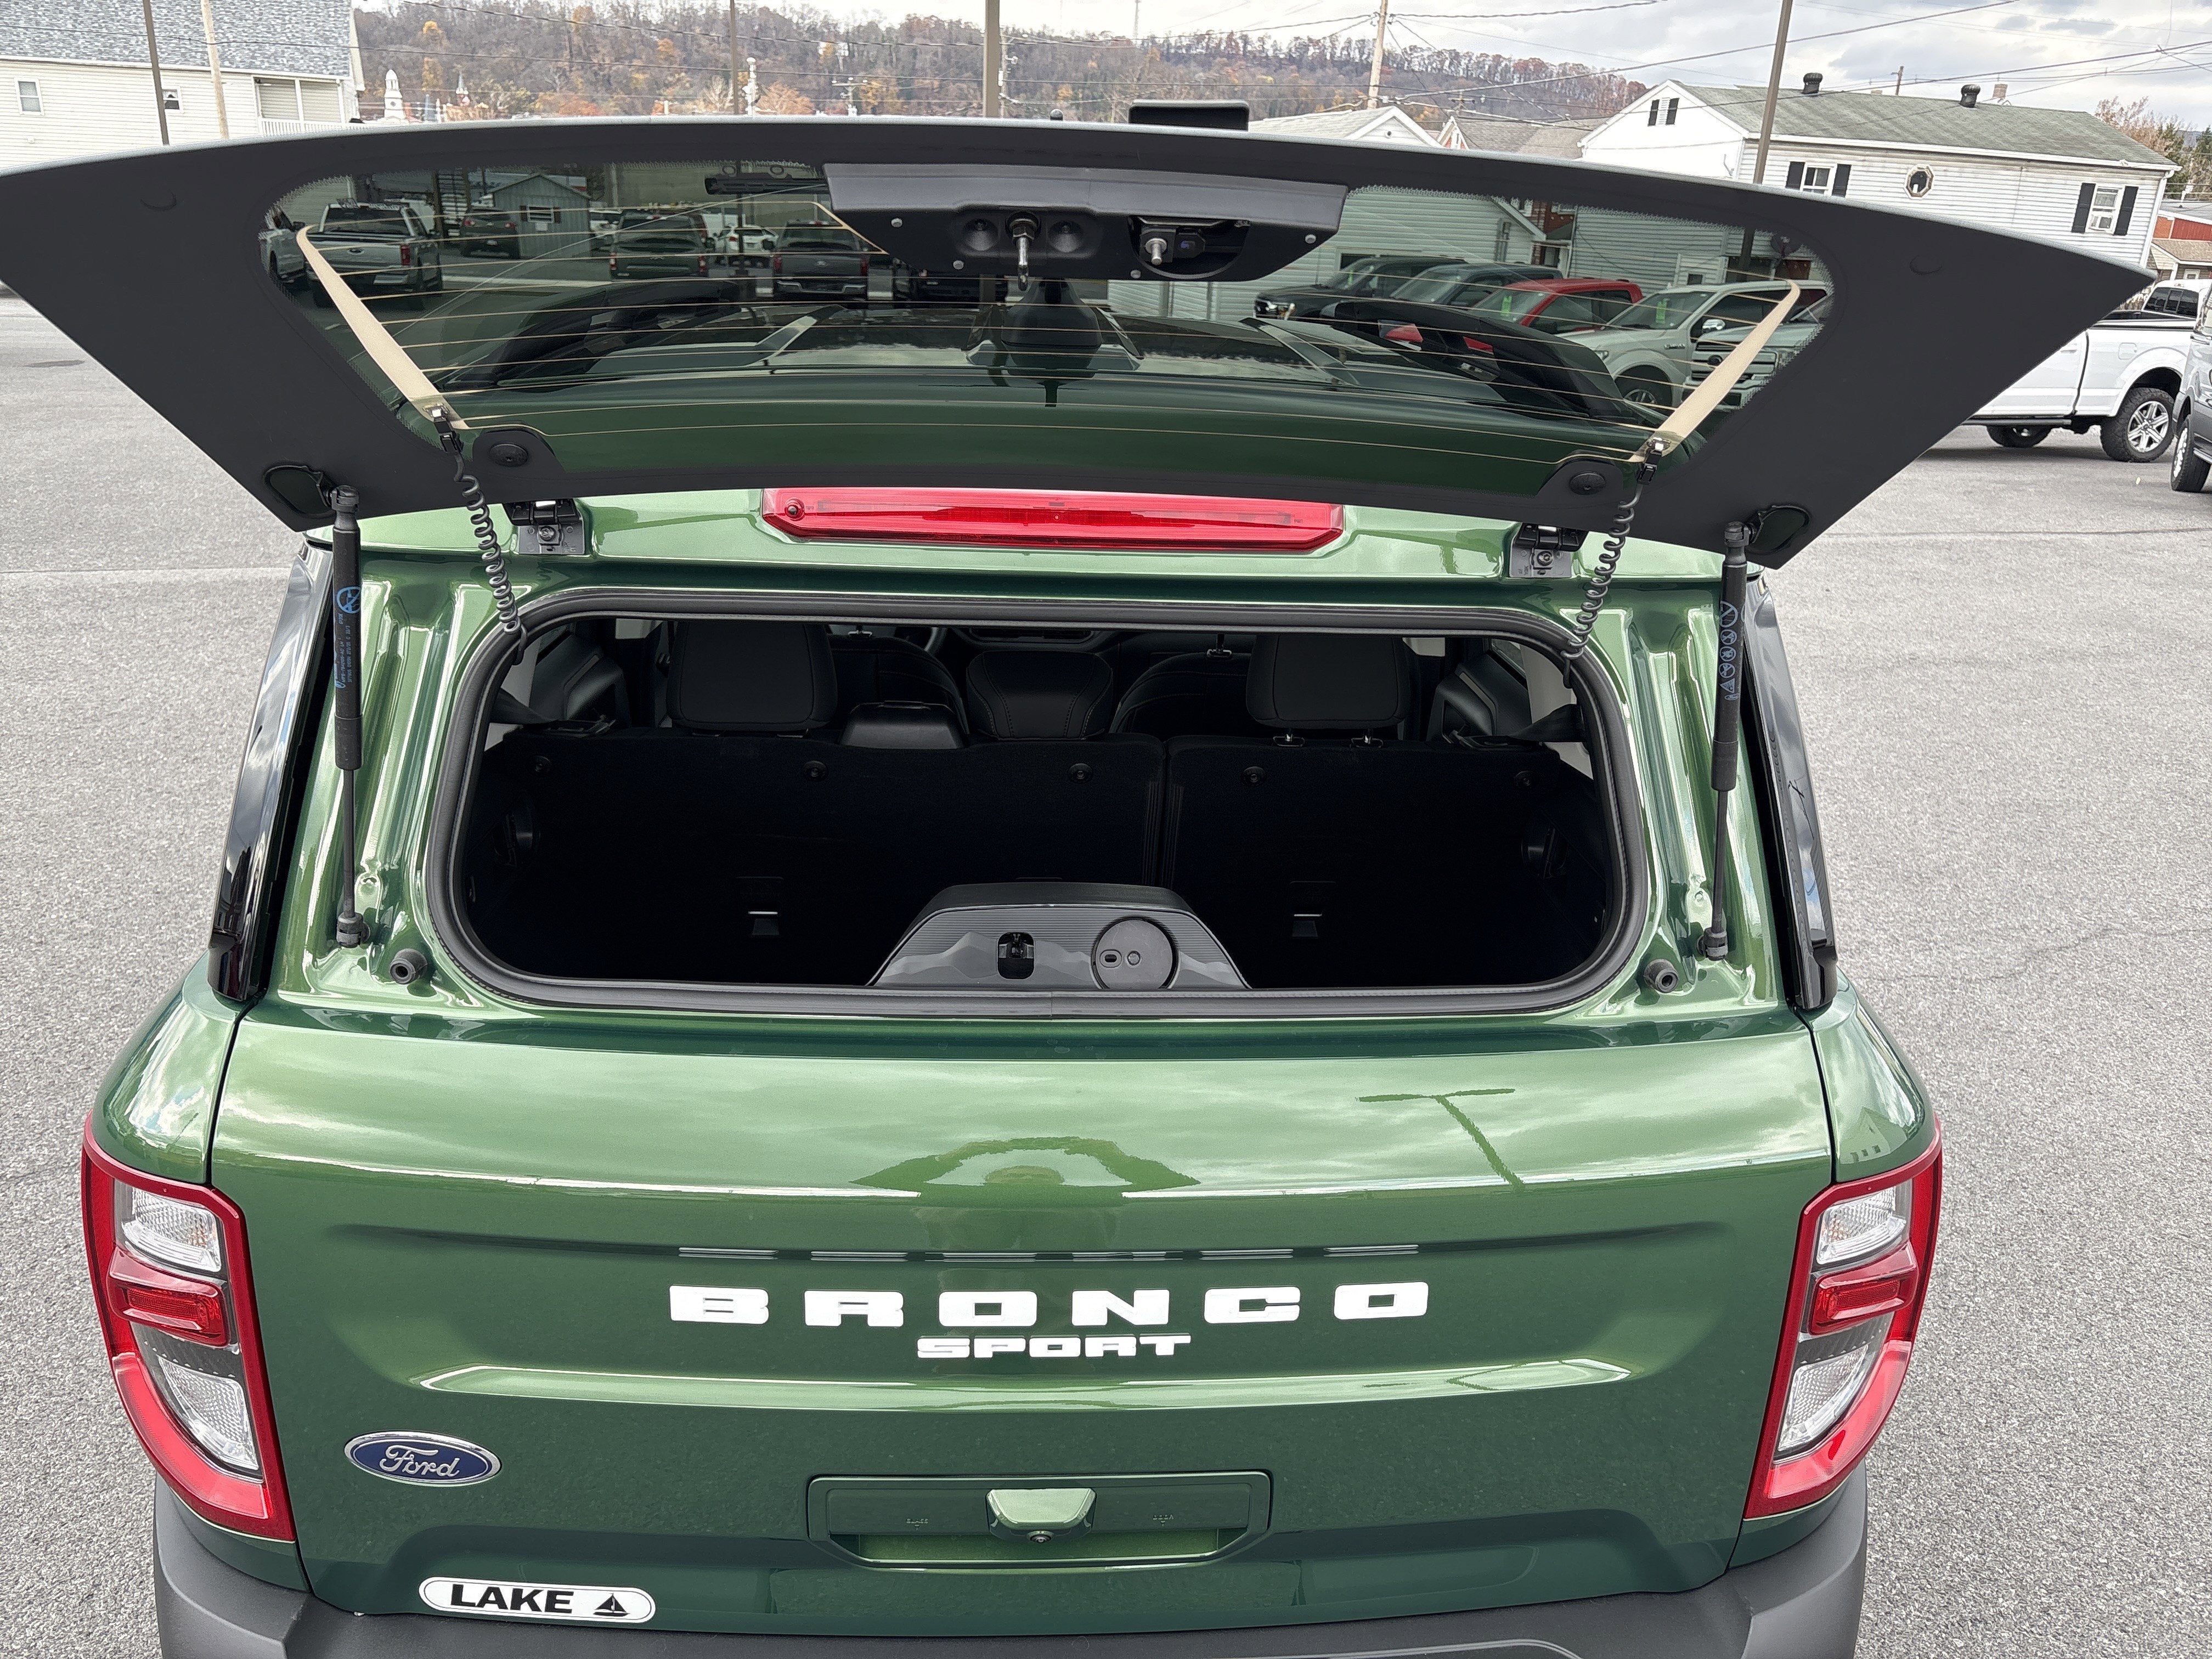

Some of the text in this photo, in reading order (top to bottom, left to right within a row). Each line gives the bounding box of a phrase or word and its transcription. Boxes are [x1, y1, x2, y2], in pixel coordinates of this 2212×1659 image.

[669, 1282, 1429, 1328] BRONCO
[917, 1335, 1192, 1359] SPORT
[379, 1444, 461, 1478] Ford
[450, 1584, 574, 1614] LAKE
